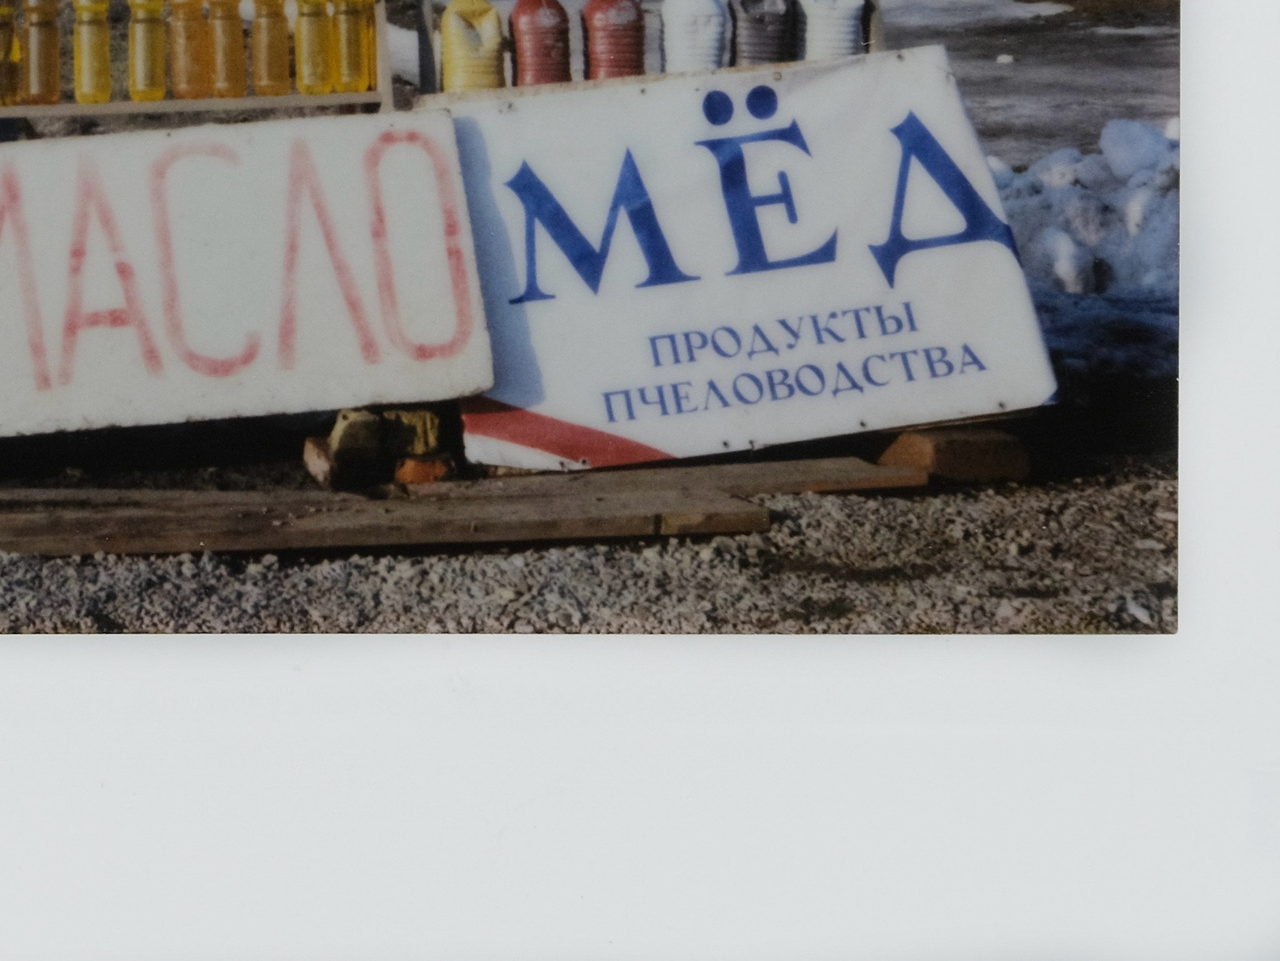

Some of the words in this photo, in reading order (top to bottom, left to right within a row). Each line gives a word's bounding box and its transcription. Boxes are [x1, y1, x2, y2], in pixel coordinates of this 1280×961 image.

[506, 85, 1021, 305] МЁД
[649, 301, 919, 368] ПРОДУКТЫ
[603, 343, 987, 424] ПЧЕЛОВОДСТВА
